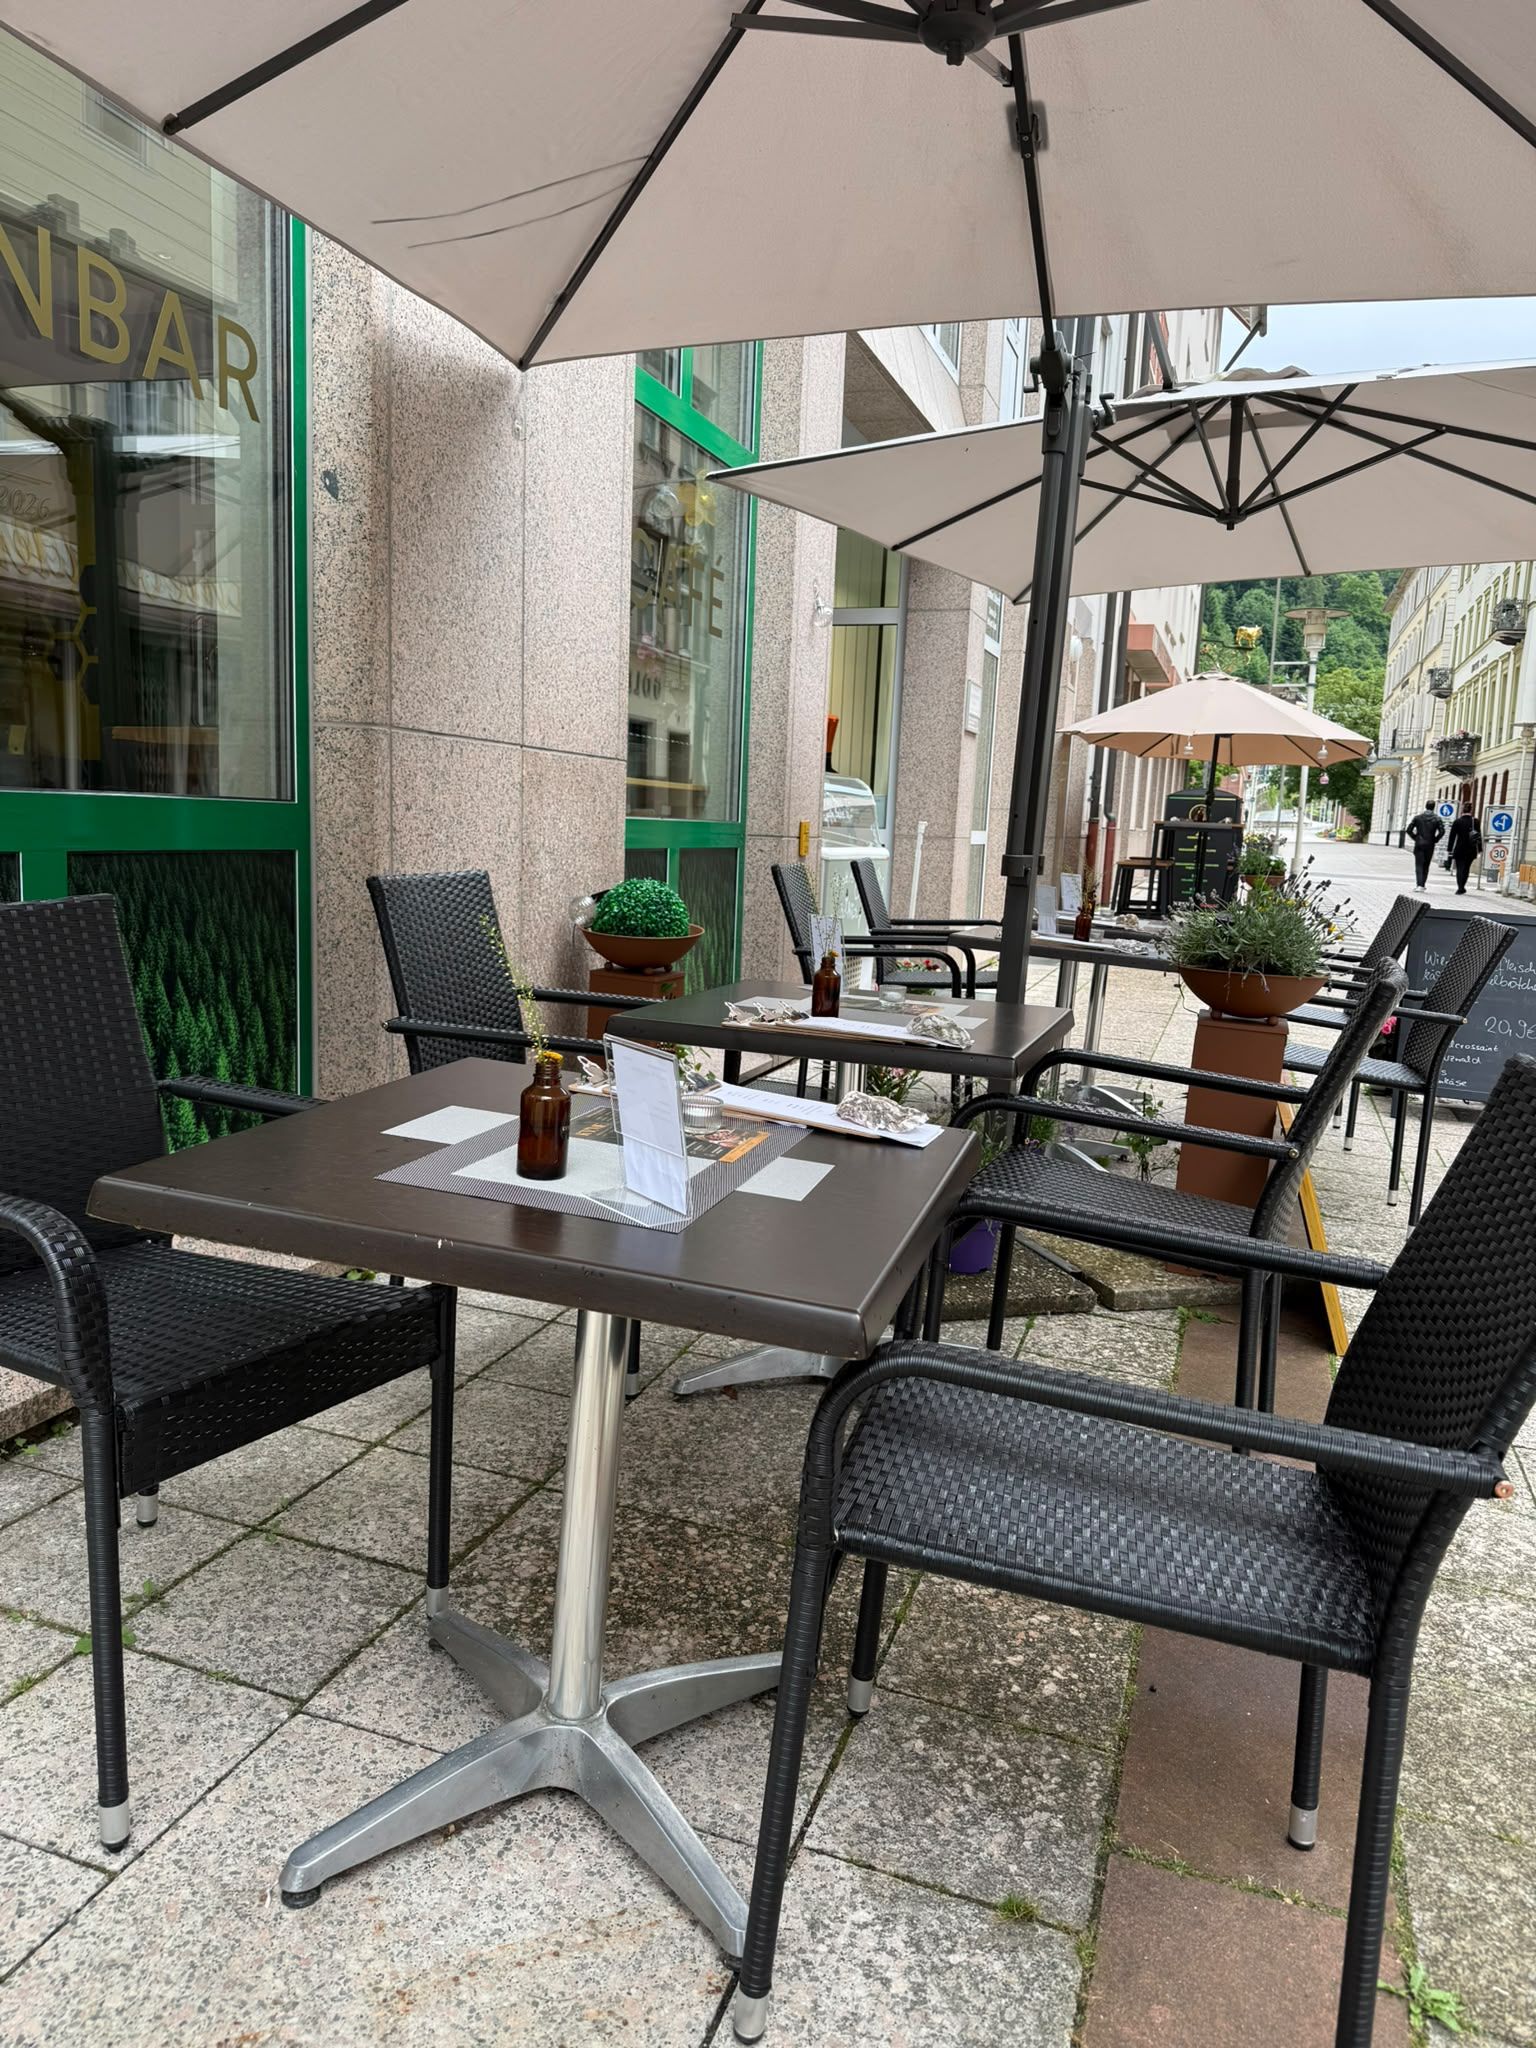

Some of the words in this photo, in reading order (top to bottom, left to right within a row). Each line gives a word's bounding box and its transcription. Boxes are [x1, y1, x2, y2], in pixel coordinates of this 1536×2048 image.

[0, 223, 260, 424] NBAR
[631, 527, 724, 640] CAFÉ
[1493, 849, 1506, 859] 30
